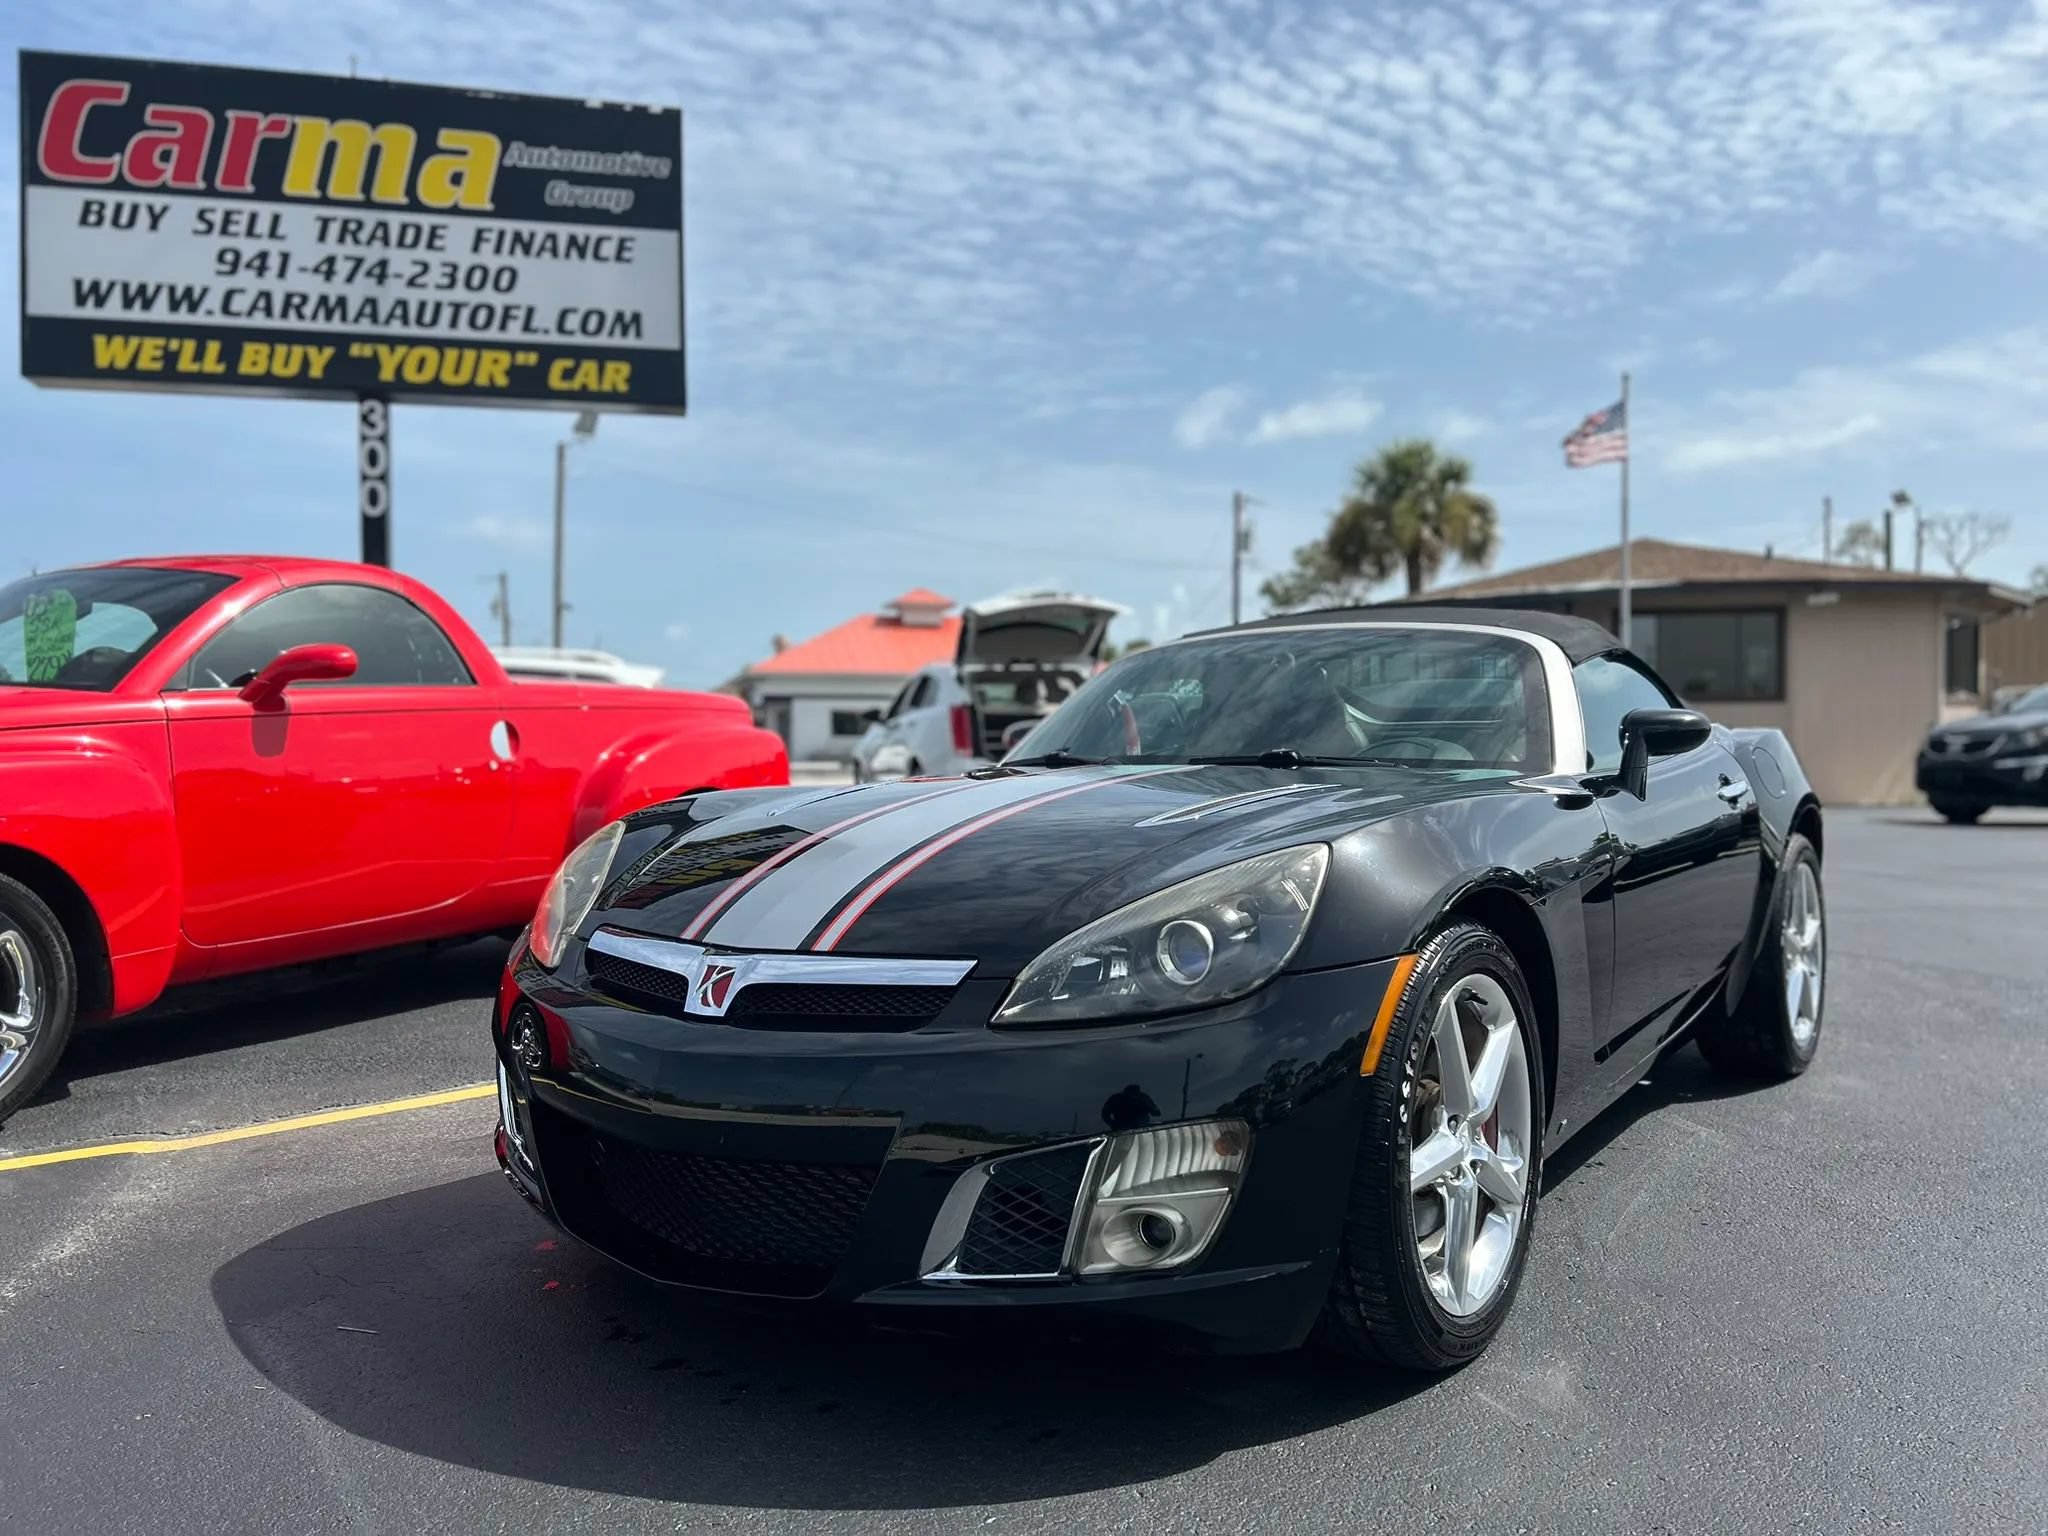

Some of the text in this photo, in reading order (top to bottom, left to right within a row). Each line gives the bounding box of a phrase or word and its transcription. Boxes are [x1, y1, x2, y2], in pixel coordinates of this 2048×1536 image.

[37, 78, 501, 211] Carma
[502, 140, 672, 179] Automotive
[544, 179, 635, 214] Group
[78, 199, 636, 263] BUY SELL TRADE FINANCE
[215, 247, 518, 293] 941-474-2300
[72, 278, 644, 340] WWW.CARMAAUTOFL.COM
[92, 334, 632, 393] WE'LL BUY "YOUR" CAR
[361, 398, 387, 518] 300
